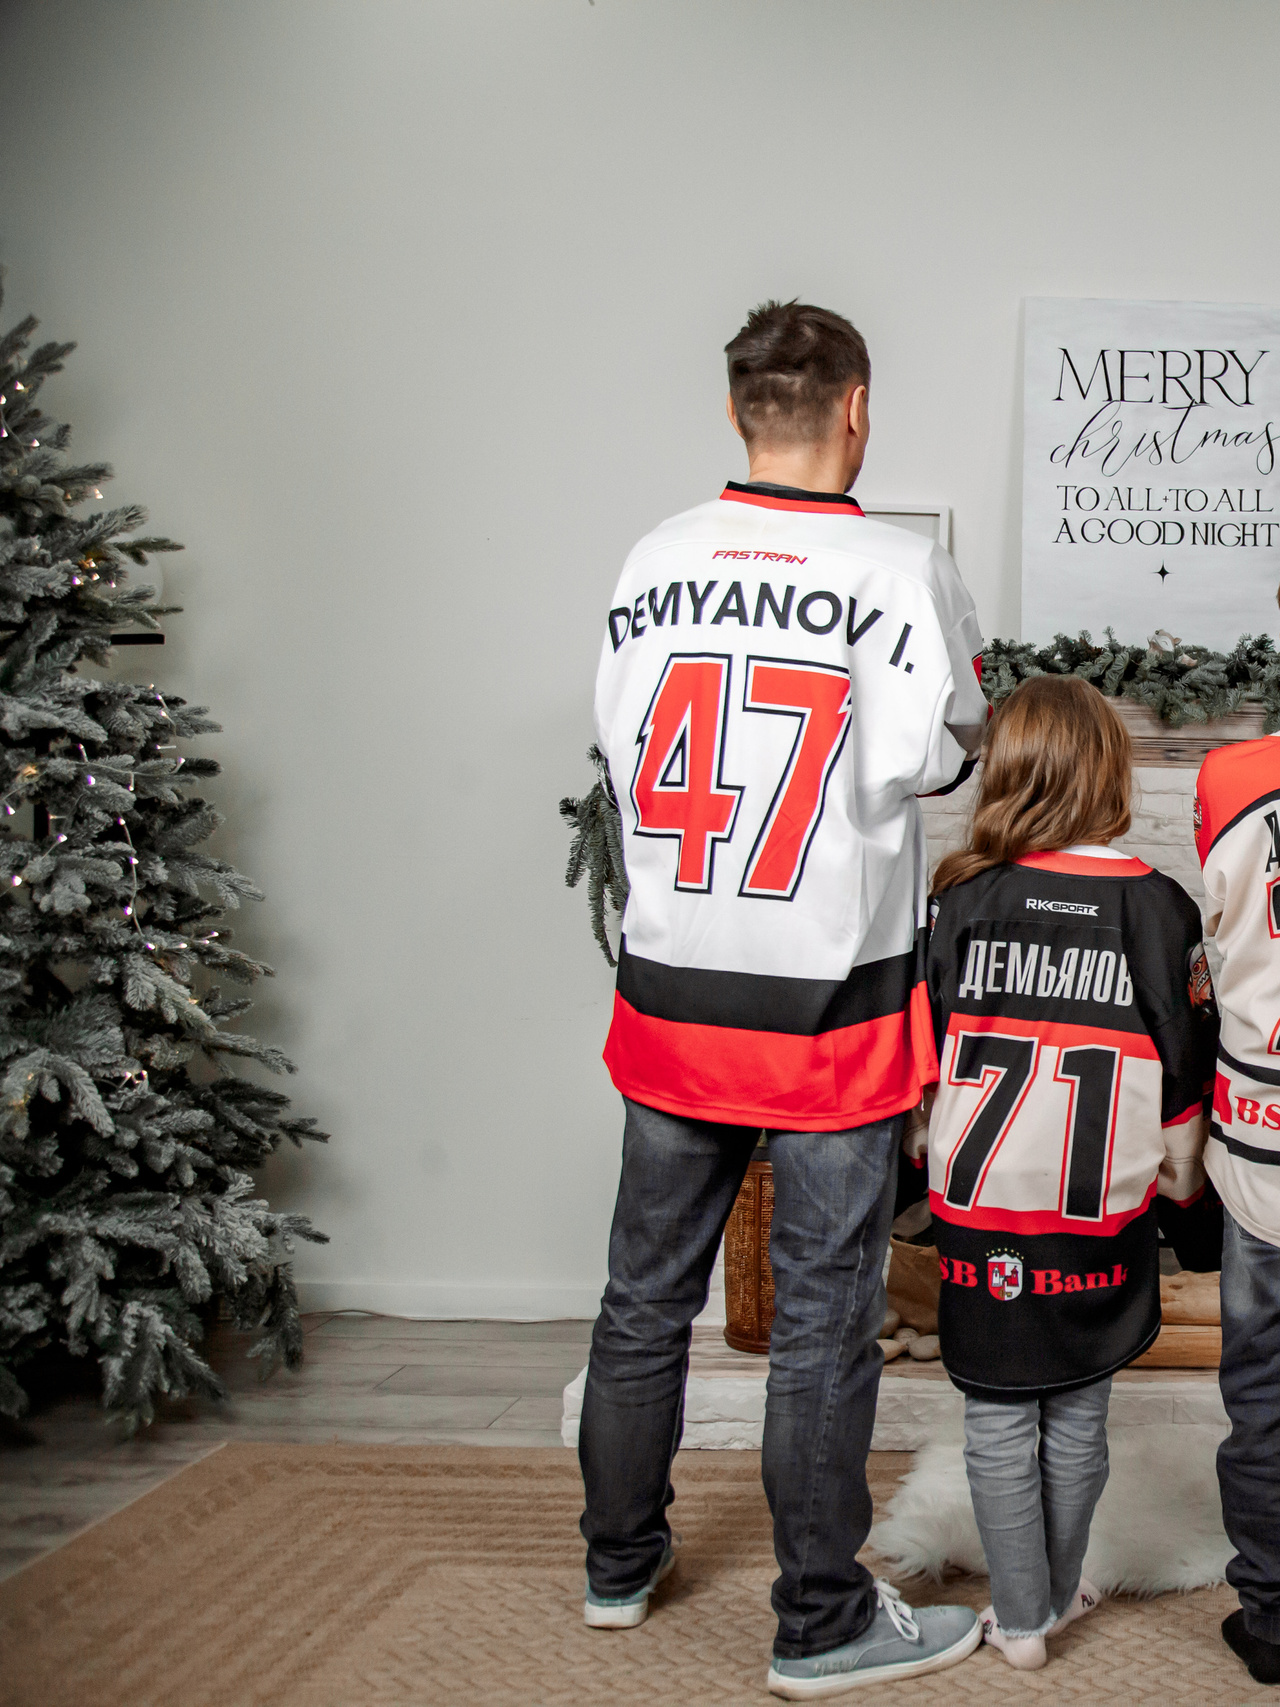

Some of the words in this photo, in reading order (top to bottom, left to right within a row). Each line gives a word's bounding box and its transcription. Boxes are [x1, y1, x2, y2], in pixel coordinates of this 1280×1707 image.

[1052, 347, 1270, 407] MERRY
[1056, 485, 1100, 511] TO
[1103, 486, 1163, 512] ALL
[1169, 488, 1208, 512] TO
[1212, 488, 1274, 513] ALL
[1052, 517, 1077, 544] A
[1081, 518, 1185, 545] GOOD
[1190, 522, 1280, 547] NIGHT
[712, 550, 808, 566] FASTRAN
[608, 580, 884, 654] DEMYANOV
[888, 623, 914, 674] I.
[629, 652, 853, 902] 47
[943, 1029, 1125, 1223] 71
[1030, 1264, 1128, 1296] Bank
